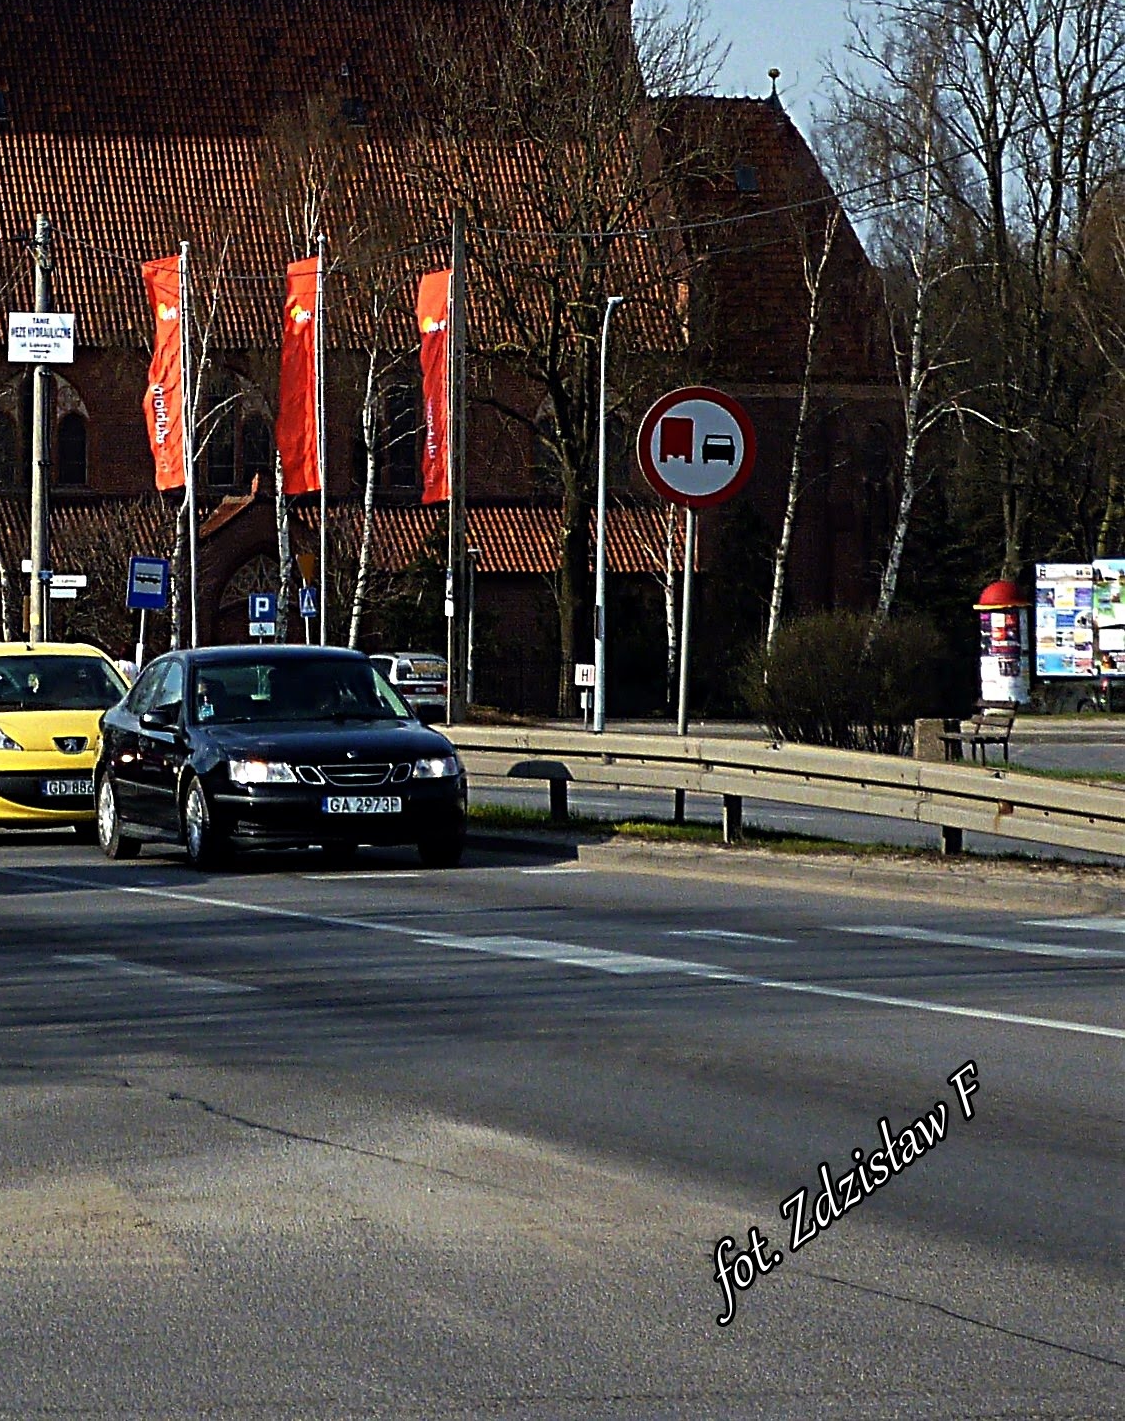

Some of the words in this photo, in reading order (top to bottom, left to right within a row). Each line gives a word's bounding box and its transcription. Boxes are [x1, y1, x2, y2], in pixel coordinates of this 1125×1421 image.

[255, 597, 270, 618] P
[49, 781, 67, 795] GD
[330, 797, 351, 812] GA
